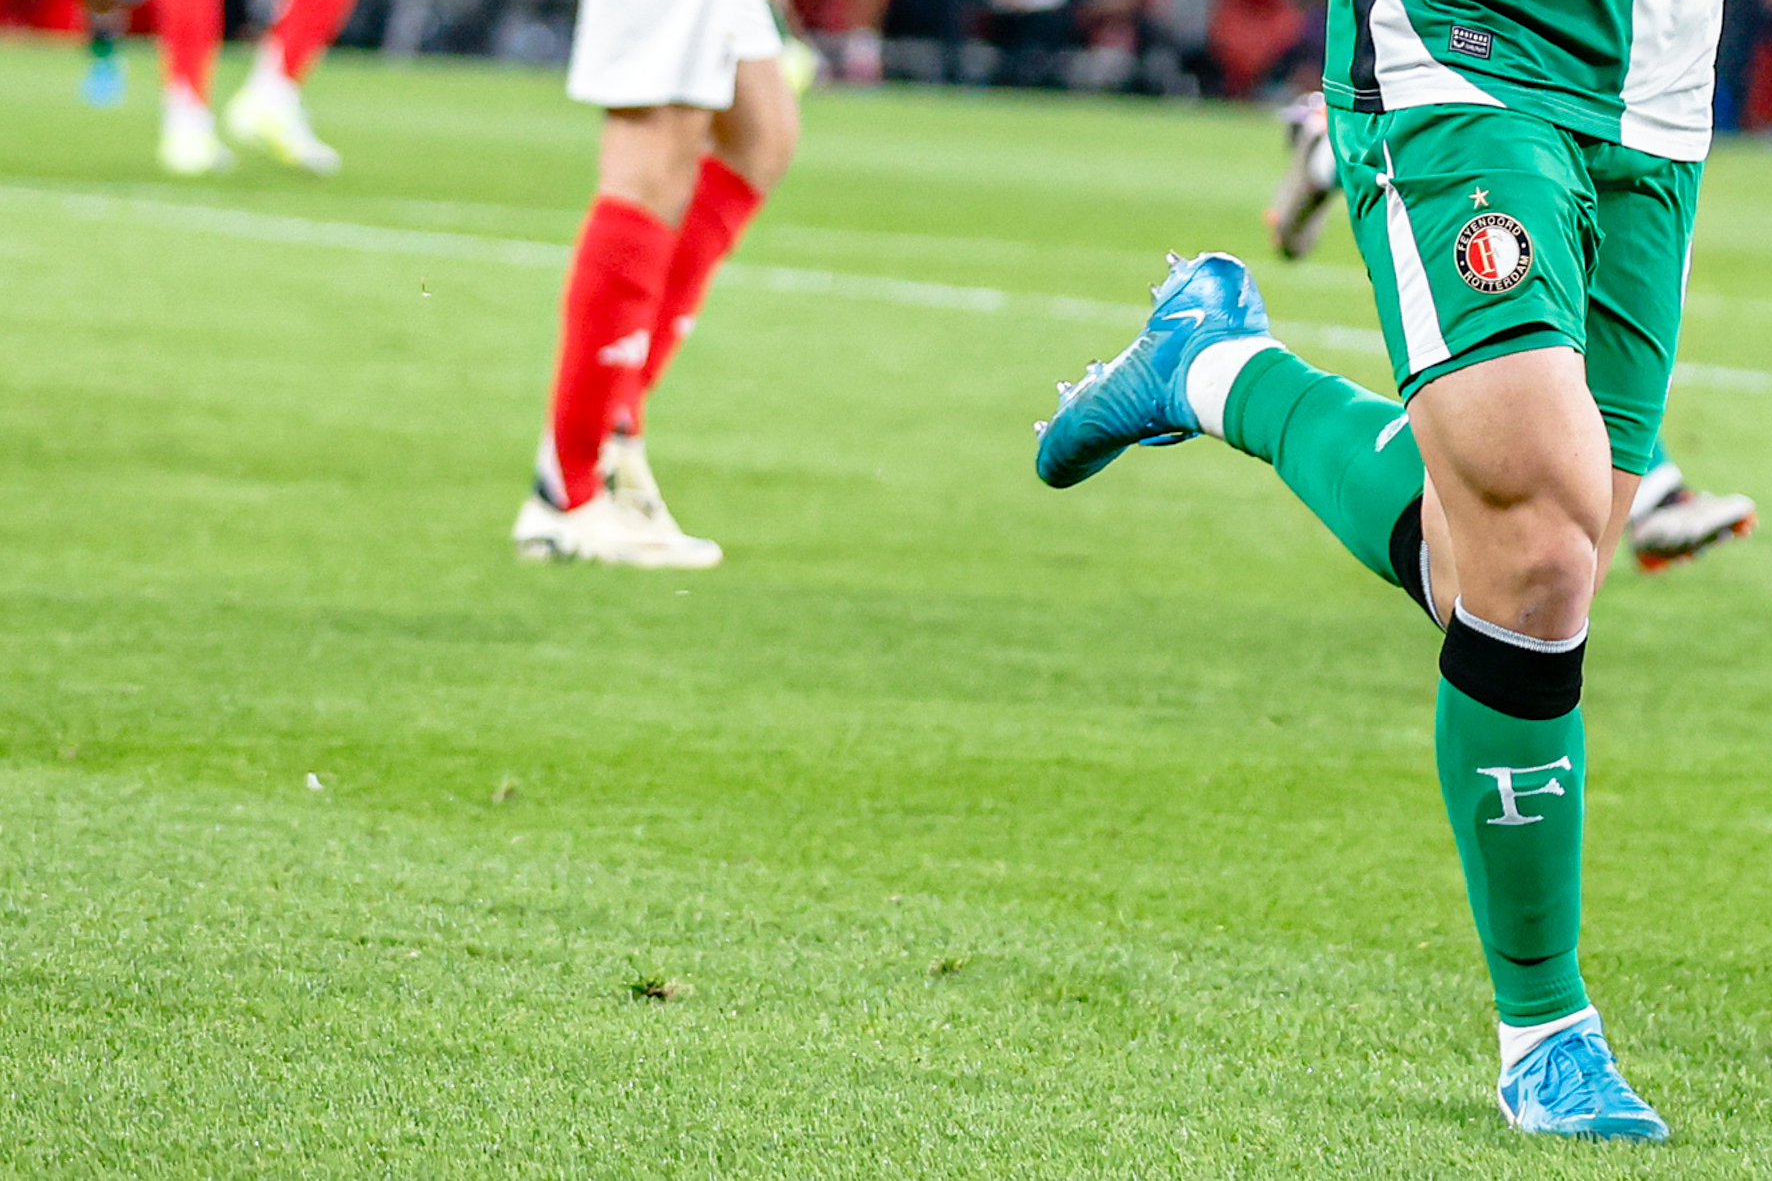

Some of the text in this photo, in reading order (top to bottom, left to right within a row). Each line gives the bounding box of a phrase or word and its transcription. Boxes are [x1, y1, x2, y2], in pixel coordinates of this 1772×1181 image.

[1458, 216, 1521, 251] FEYENOORD
[1463, 255, 1530, 291] ROTTERDAM
[1476, 755, 1572, 826] F
